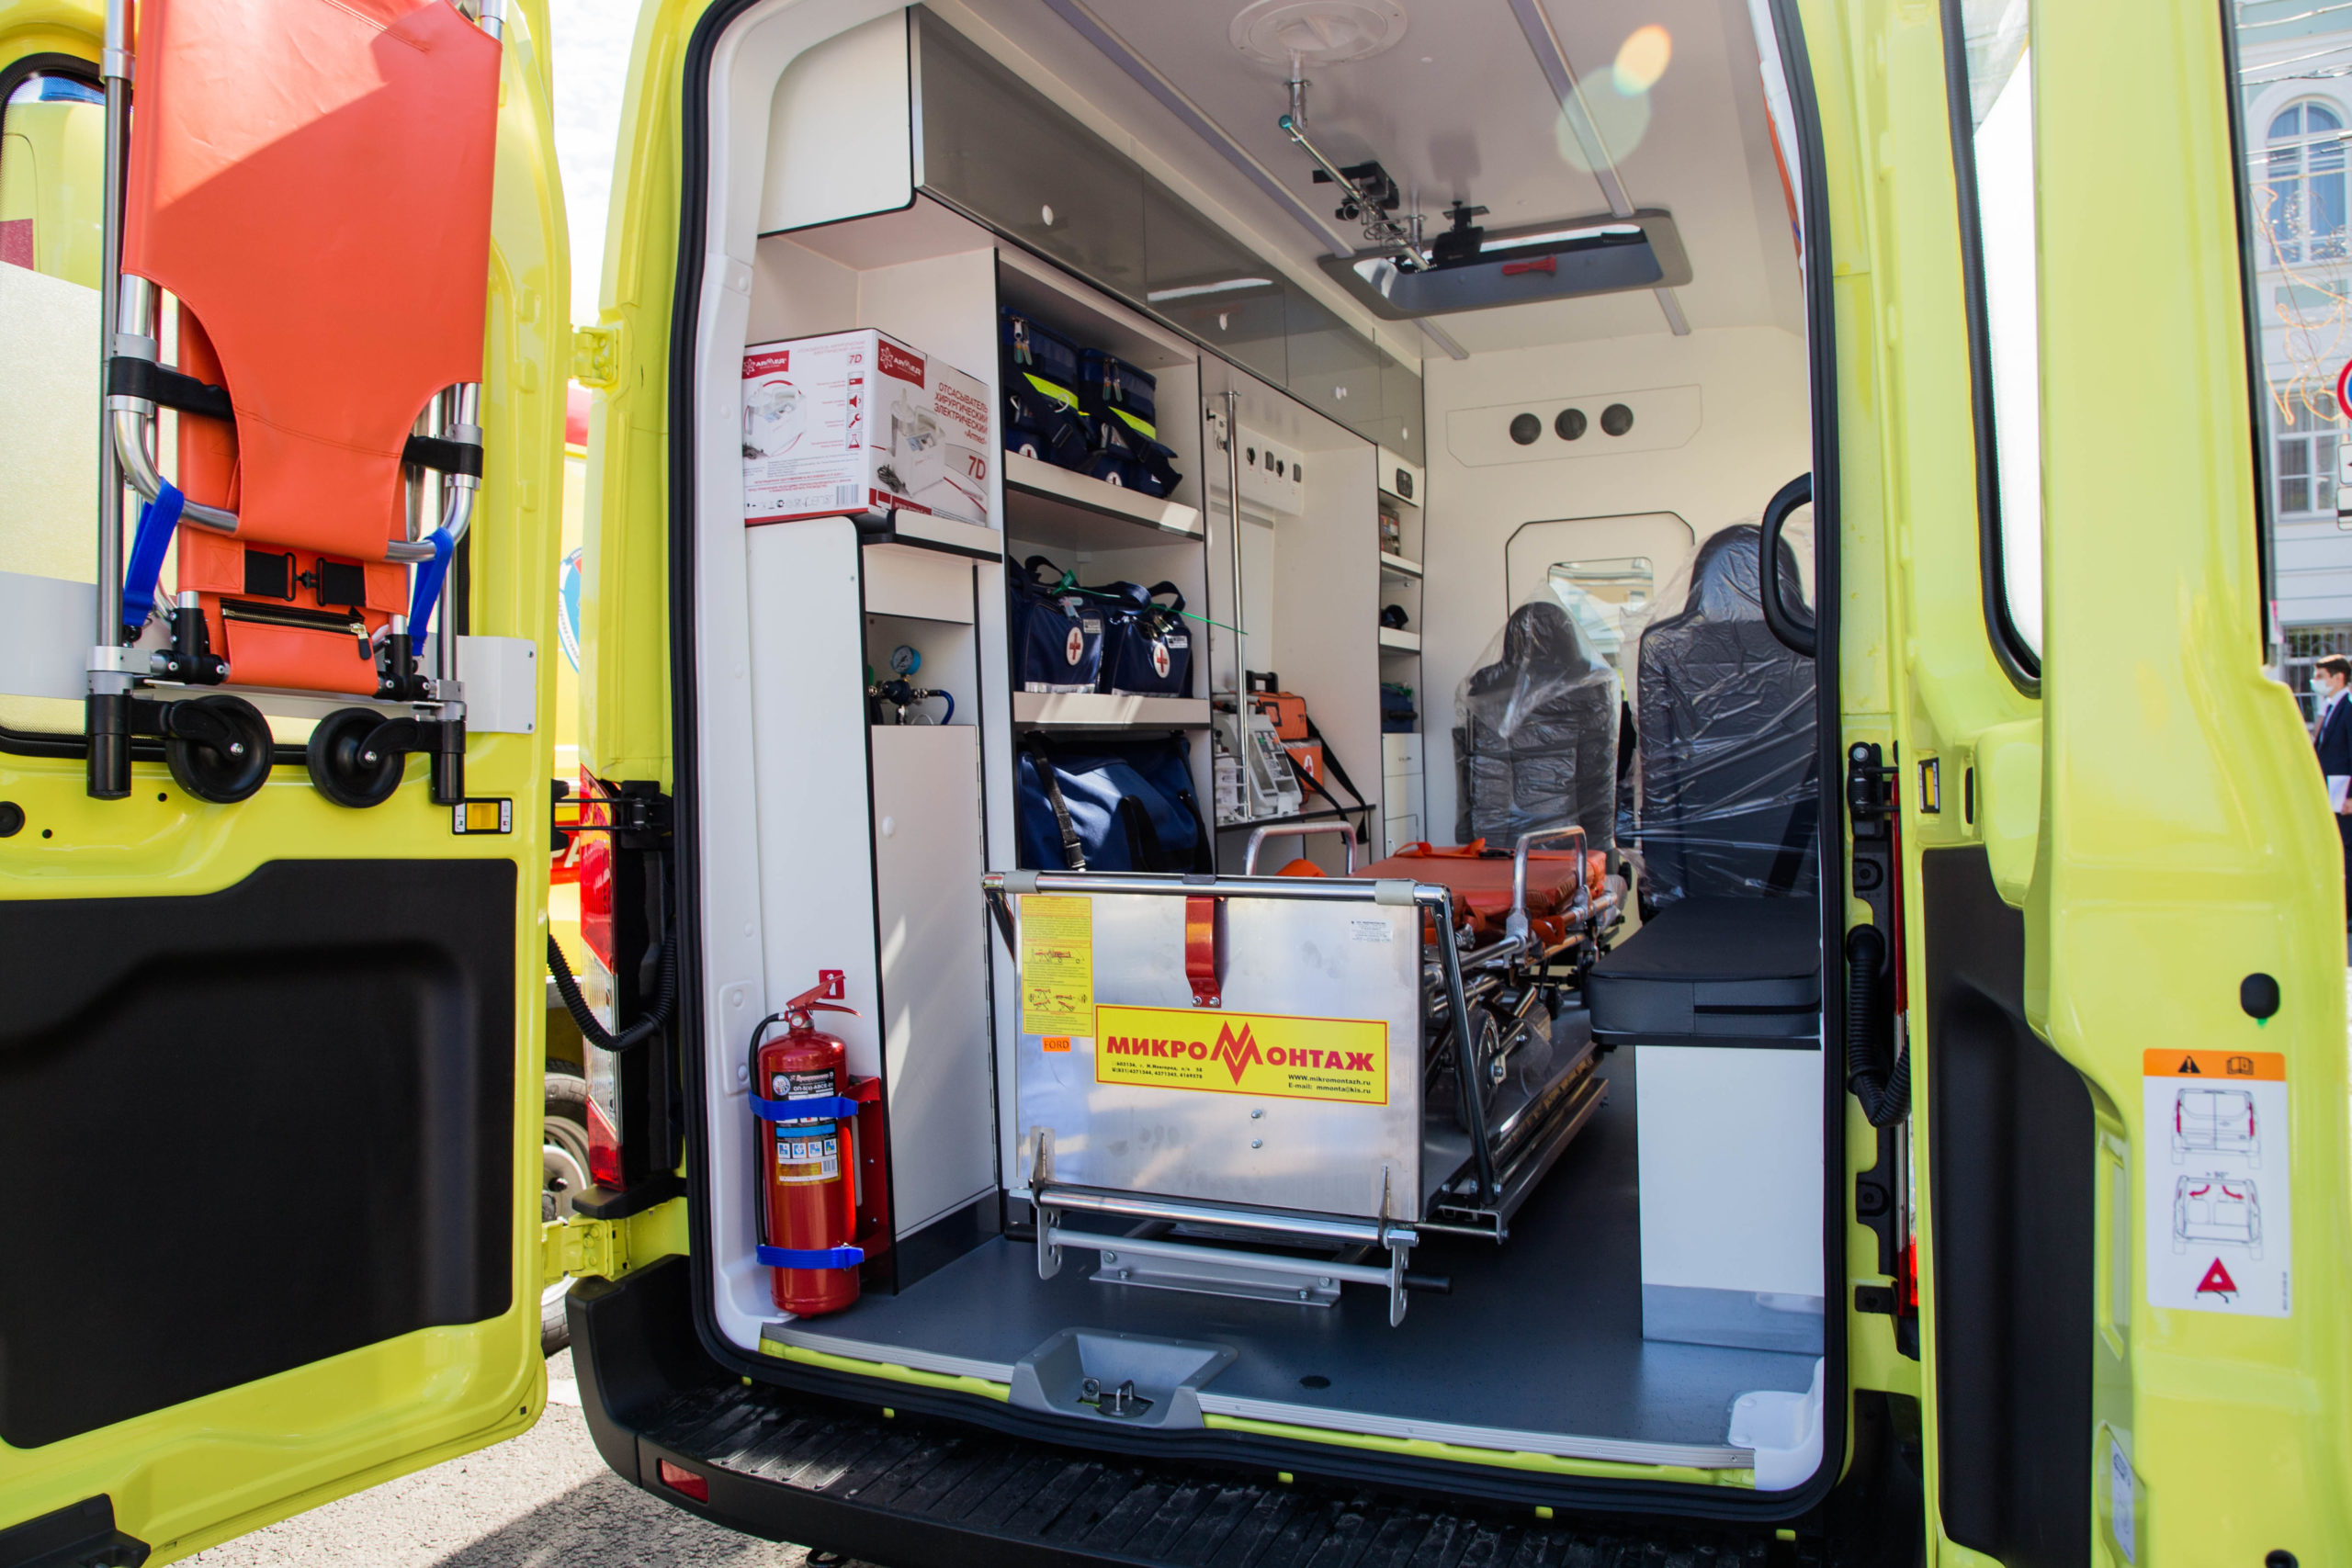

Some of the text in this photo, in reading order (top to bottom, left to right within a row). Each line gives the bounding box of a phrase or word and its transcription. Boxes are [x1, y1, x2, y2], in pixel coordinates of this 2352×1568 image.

[848, 354, 863, 364] 7D
[938, 382, 989, 413] ОТСАСЫВАТЕЛЬ
[968, 455, 986, 480] 7D
[1044, 1040, 1070, 1051] FORD
